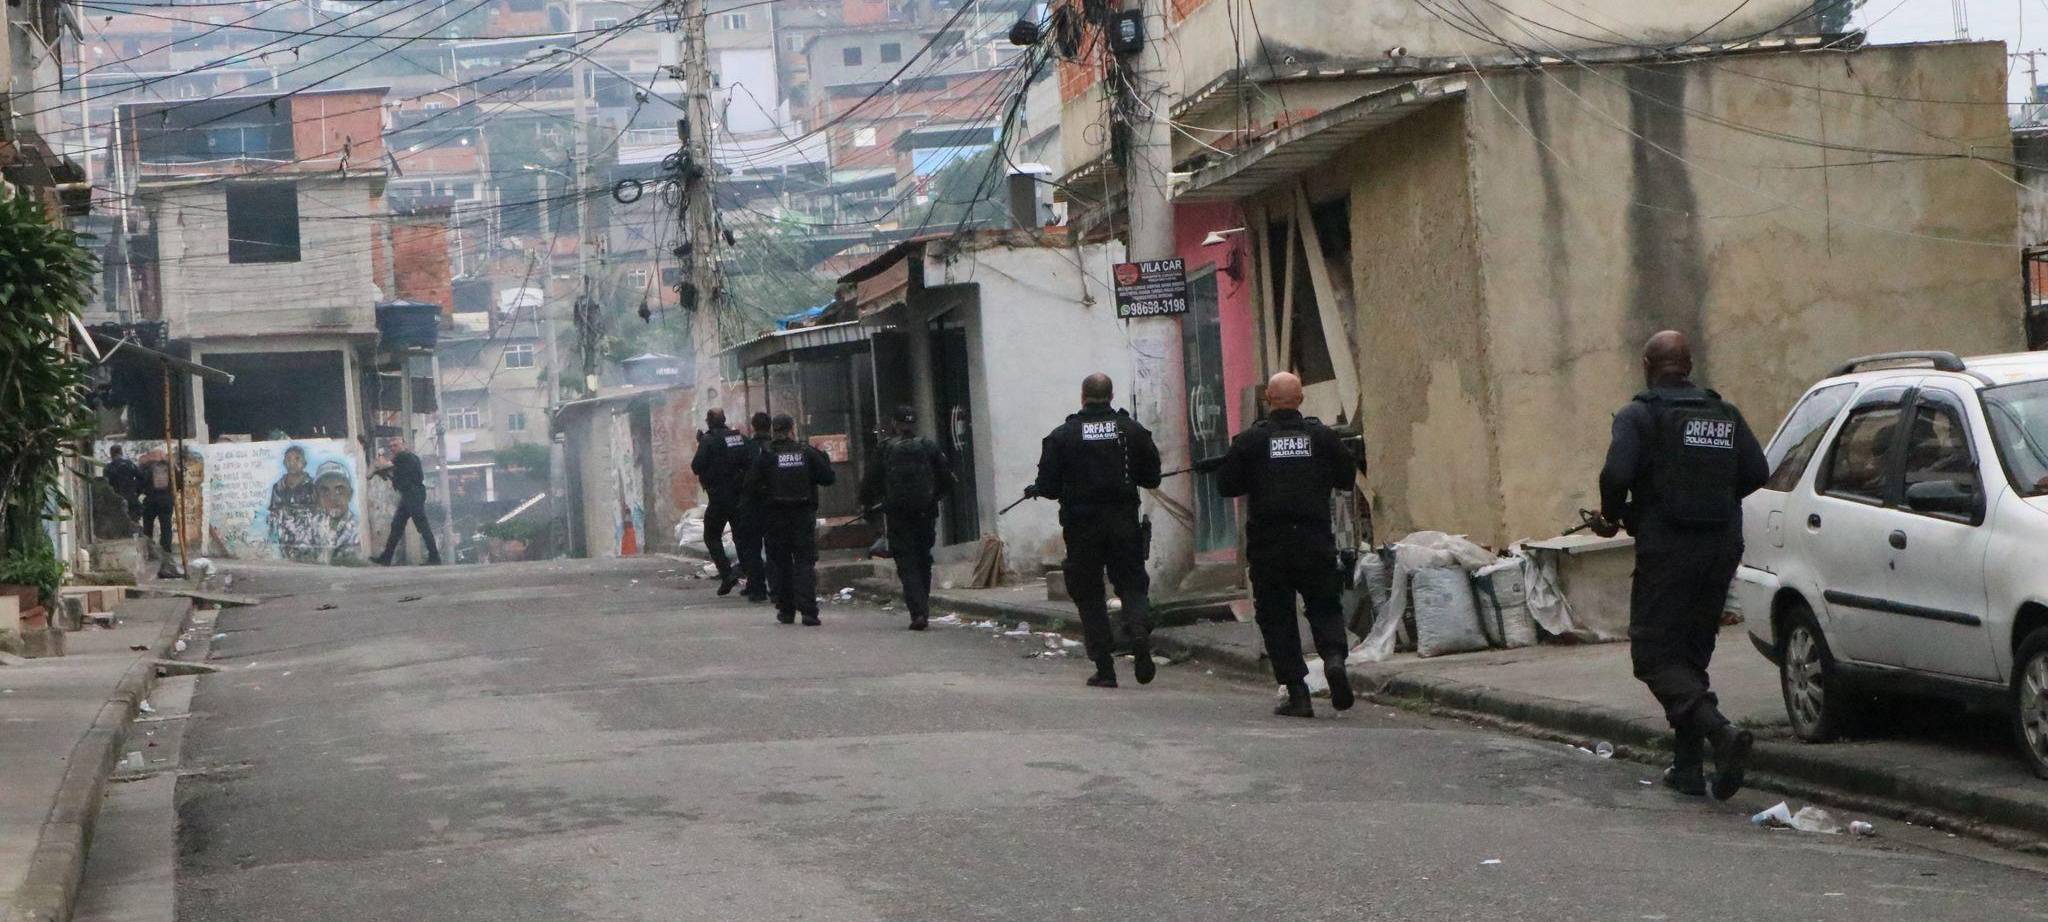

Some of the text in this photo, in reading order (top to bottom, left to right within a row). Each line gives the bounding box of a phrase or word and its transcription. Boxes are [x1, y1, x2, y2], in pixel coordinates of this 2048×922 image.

[1140, 260, 1182, 273] VILA CAR
[1130, 299, 1186, 315] 98698-3198
[1083, 422, 1116, 434] DRFA-BF
[1686, 421, 1732, 438] DRFA-BF
[1271, 438, 1309, 450] DRFA-BF
